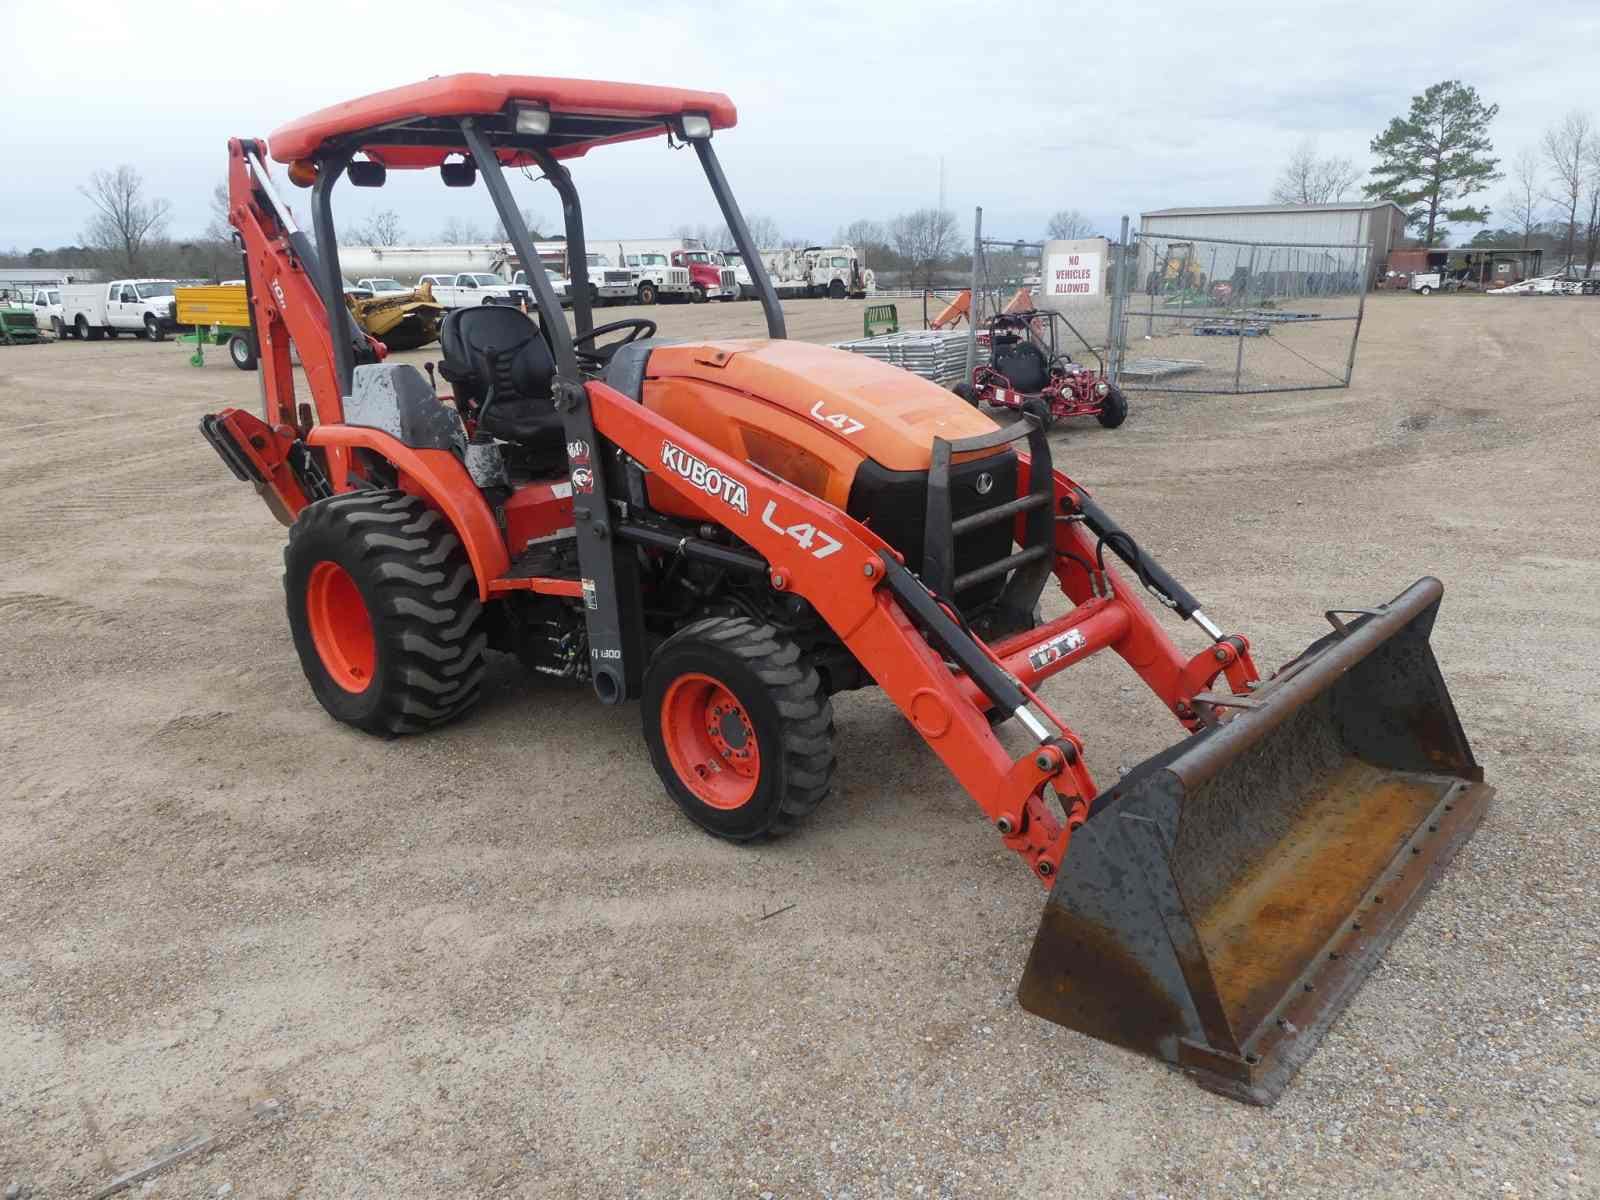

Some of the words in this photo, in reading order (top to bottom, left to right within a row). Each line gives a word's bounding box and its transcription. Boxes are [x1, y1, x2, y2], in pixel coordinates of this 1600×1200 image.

[1069, 255, 1080, 266] NO
[1056, 269, 1091, 280] VEHICLES
[1056, 283, 1090, 293] ALLOWED
[810, 400, 865, 435] L47
[660, 440, 749, 516] KUBOTA
[761, 500, 843, 559] L47
